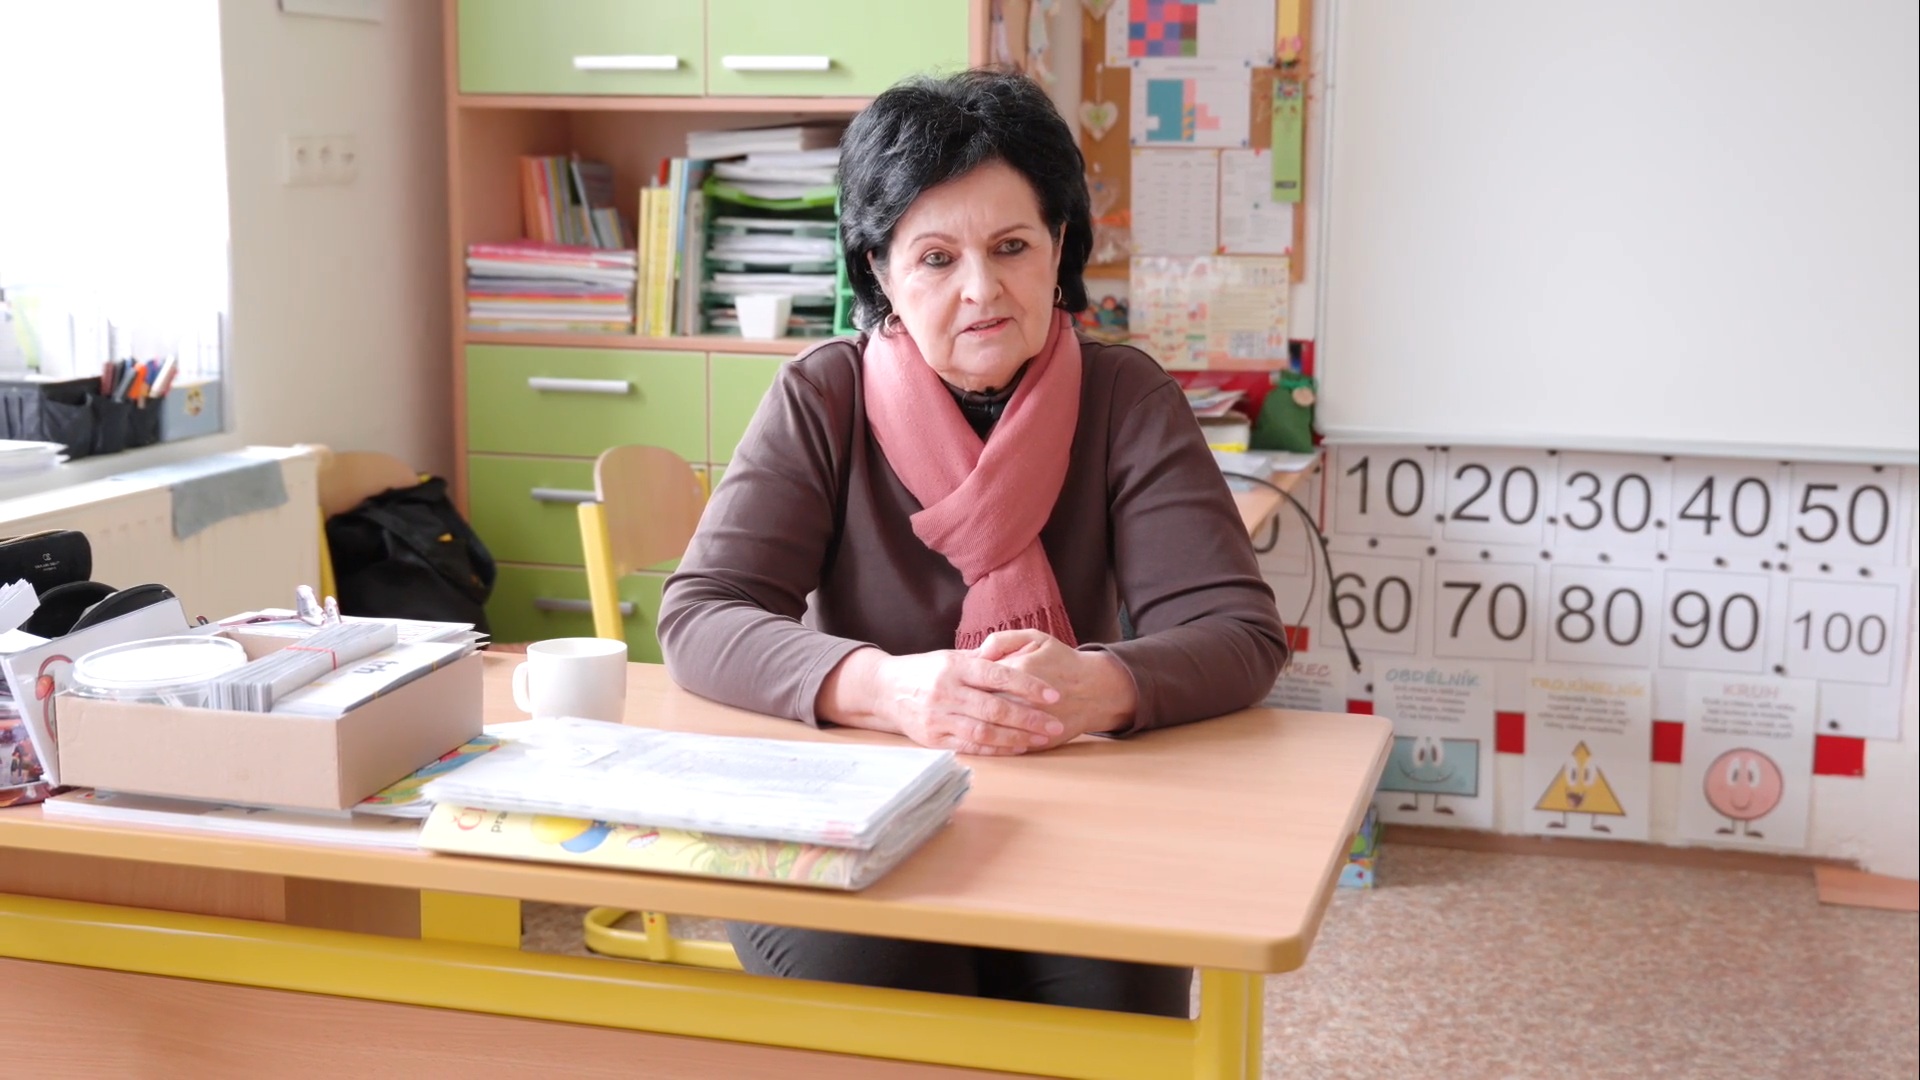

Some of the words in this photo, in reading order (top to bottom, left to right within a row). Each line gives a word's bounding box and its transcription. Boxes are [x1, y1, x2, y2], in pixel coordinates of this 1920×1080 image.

[1346, 456, 1424, 517] 10
[1450, 463, 1539, 525] 20
[1563, 471, 1651, 533] 30
[1678, 476, 1771, 537] 40
[1796, 483, 1890, 545] 50
[1328, 572, 1412, 633] 60
[1443, 581, 1527, 641] 70
[1556, 584, 1643, 646] 80
[1670, 590, 1759, 652] 90
[1794, 611, 1886, 655] 100
